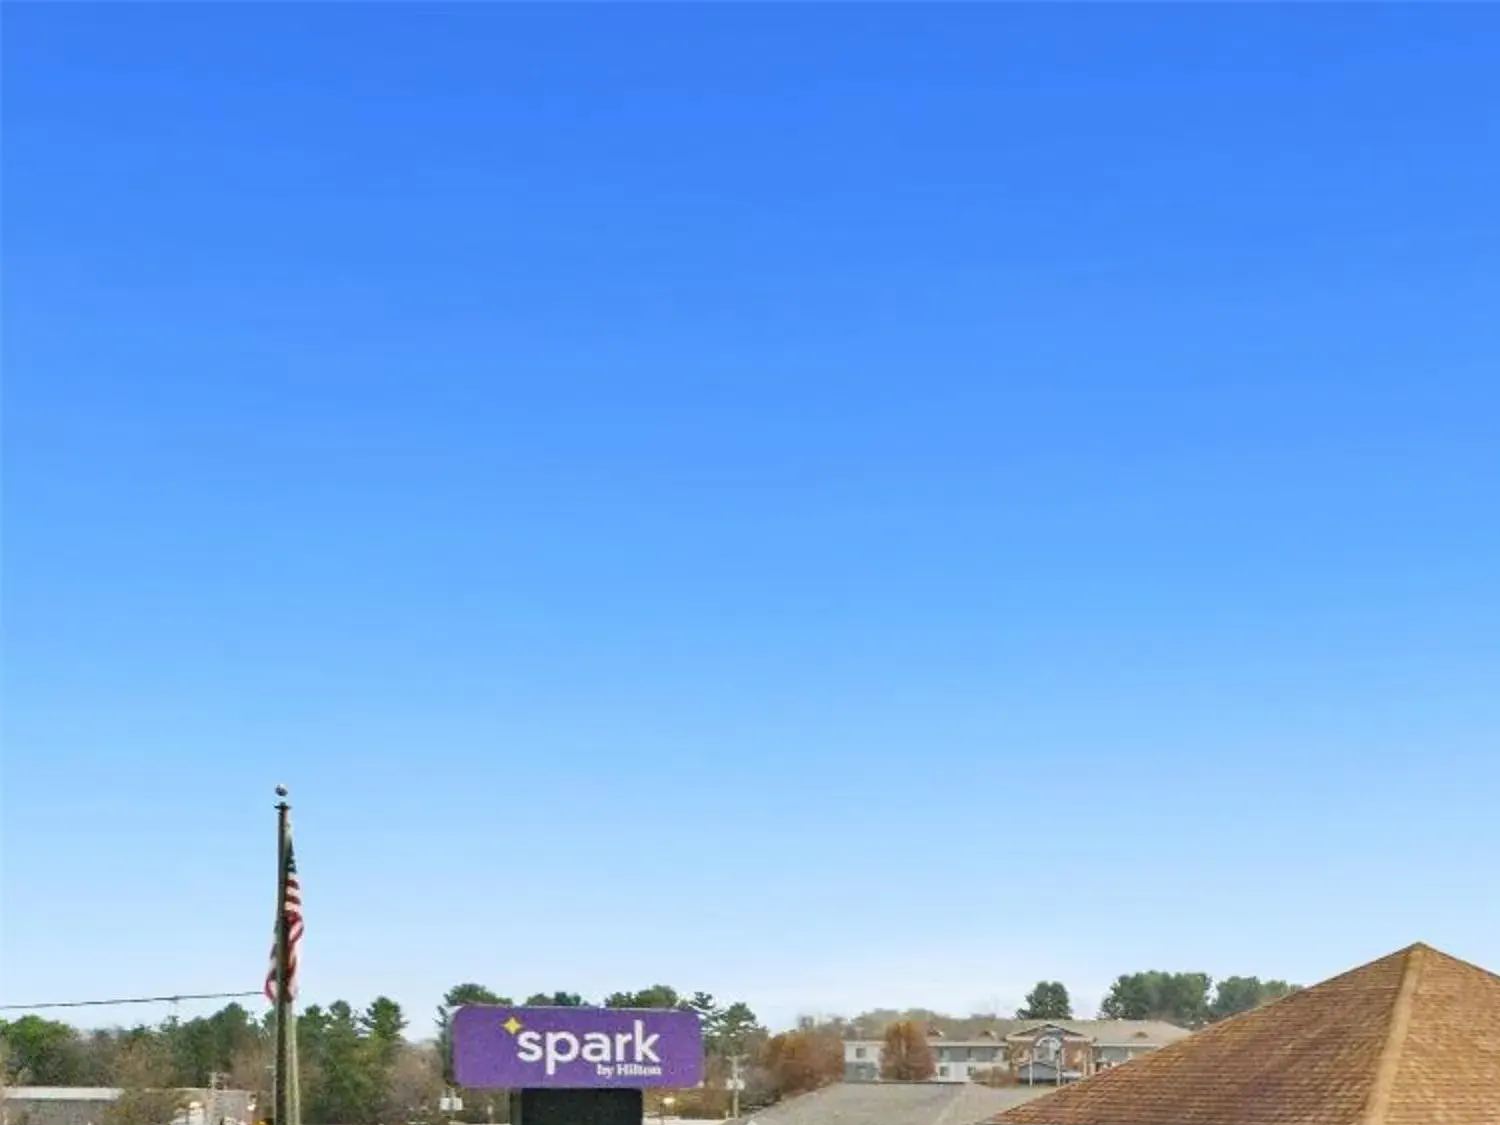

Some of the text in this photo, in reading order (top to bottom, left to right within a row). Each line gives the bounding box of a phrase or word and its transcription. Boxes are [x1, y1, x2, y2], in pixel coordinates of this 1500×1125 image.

[517, 1019, 661, 1075] spark
[597, 1064, 662, 1079] by Hilton
